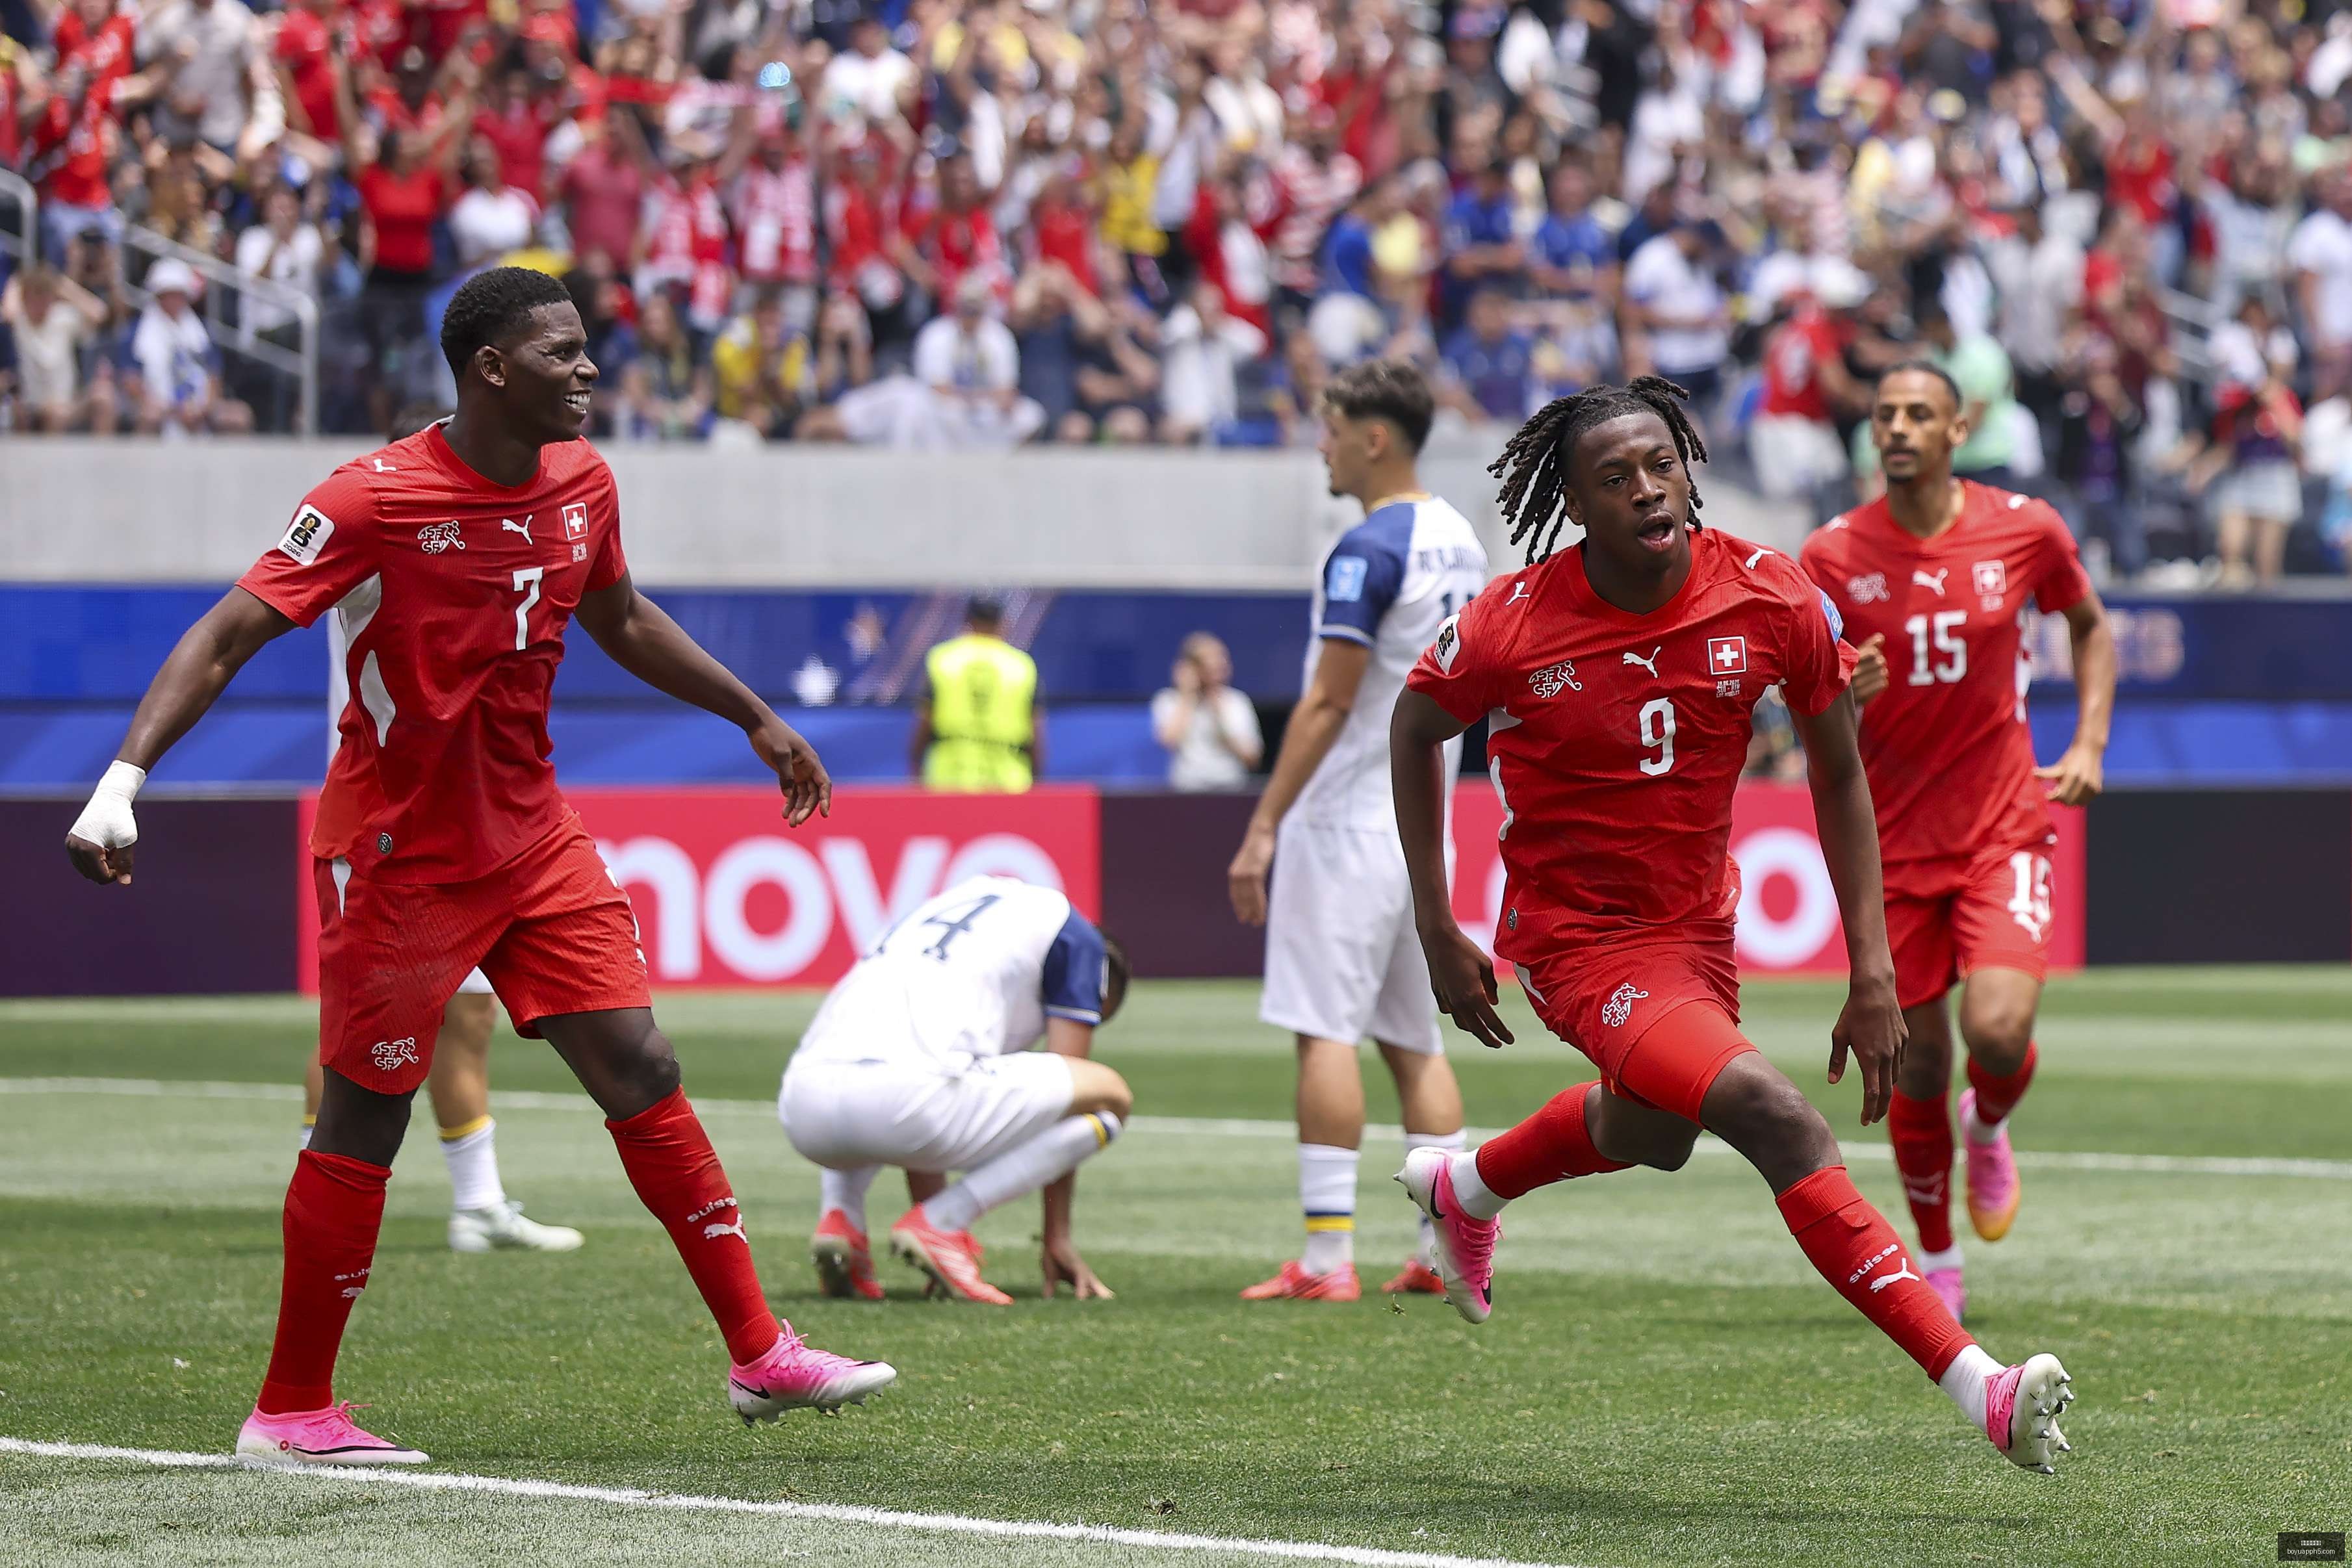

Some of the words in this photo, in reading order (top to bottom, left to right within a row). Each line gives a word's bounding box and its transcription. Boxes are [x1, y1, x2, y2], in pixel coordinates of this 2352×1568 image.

[283, 543, 302, 557] 2026
[513, 567, 544, 651] 7
[1905, 610, 1968, 687] 15
[1639, 697, 1676, 776] 9
